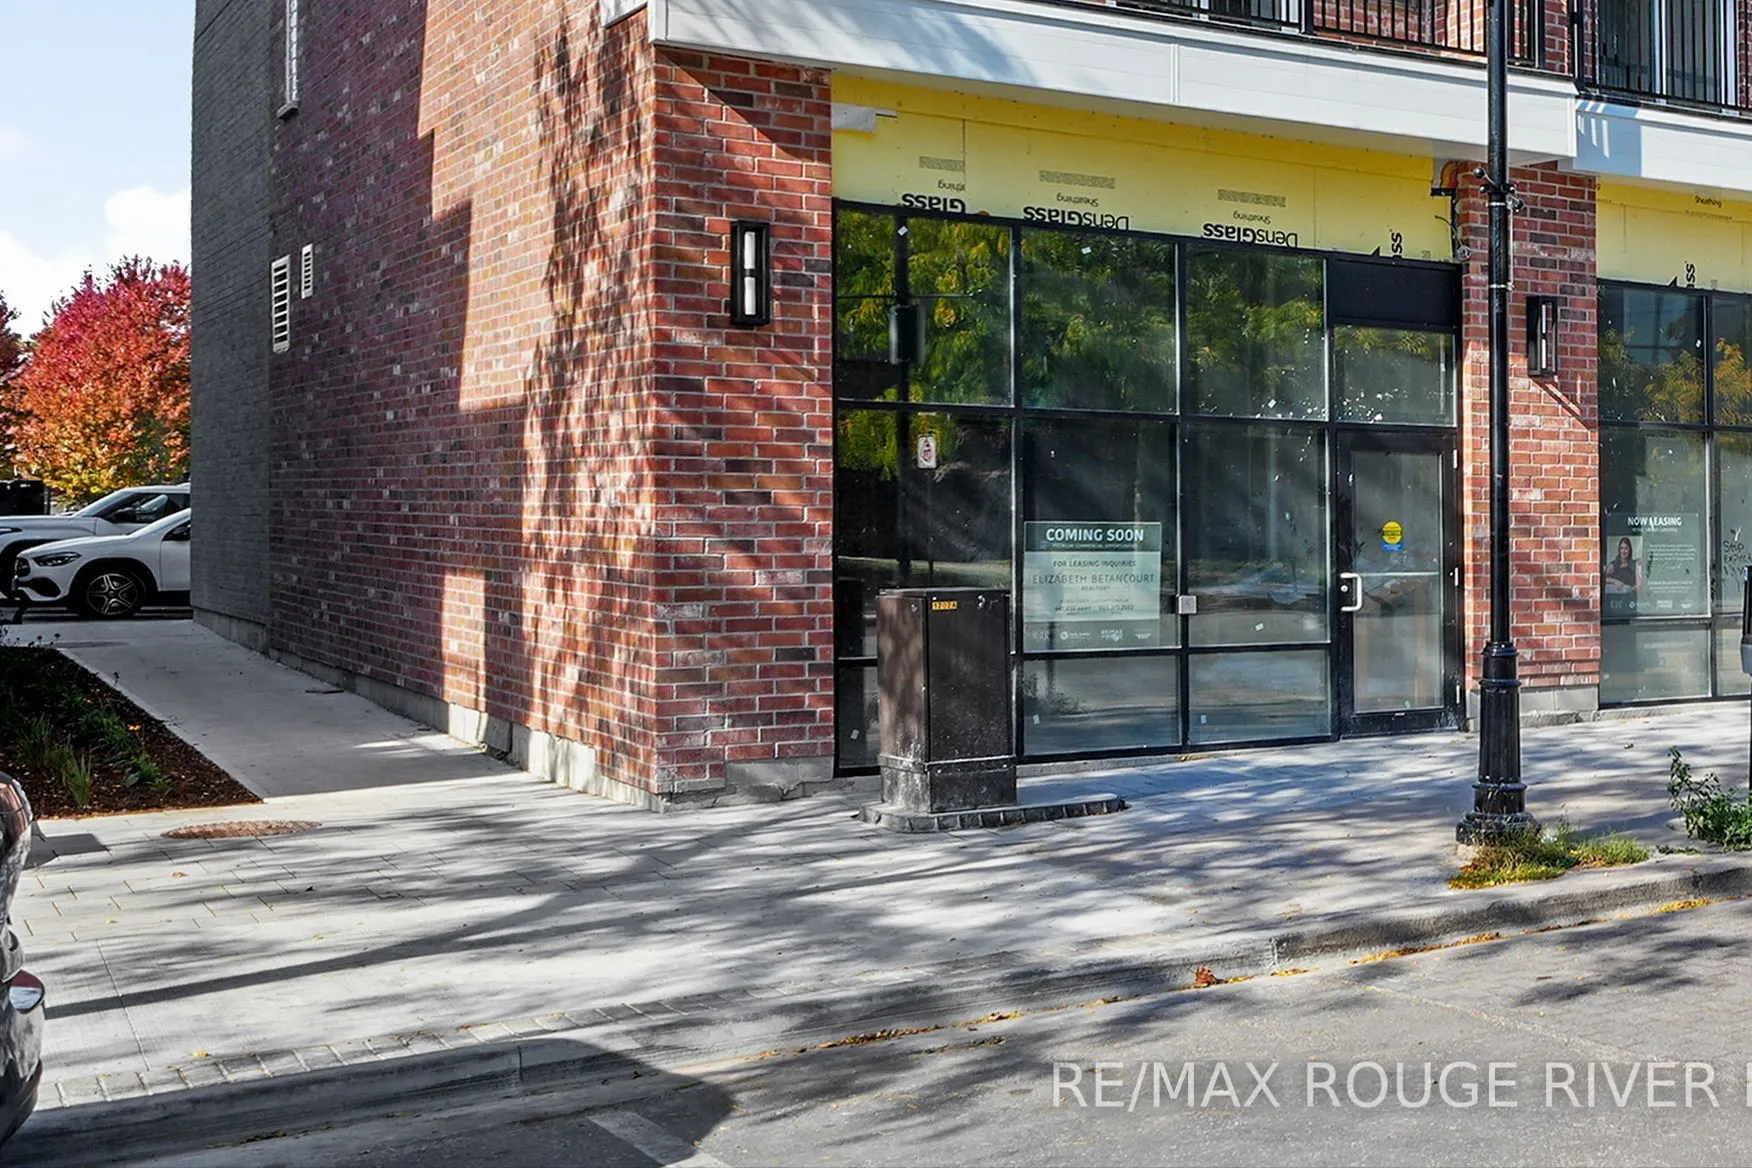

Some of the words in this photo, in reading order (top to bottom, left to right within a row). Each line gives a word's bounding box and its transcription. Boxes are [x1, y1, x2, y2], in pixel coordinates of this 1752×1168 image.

[1057, 192, 1099, 207] Sheathing
[1695, 195, 1722, 208] Sheathing
[1023, 205, 1129, 230] DensGlass
[1233, 210, 1271, 225] Sheathing
[1203, 223, 1298, 248] DensGlass
[1627, 517, 1648, 526] NOW
[1046, 529, 1103, 541] COMING
[1106, 528, 1144, 541] SOON
[1032, 575, 1087, 584] ELIZABETH
[1092, 574, 1154, 583] BETANCOURT
